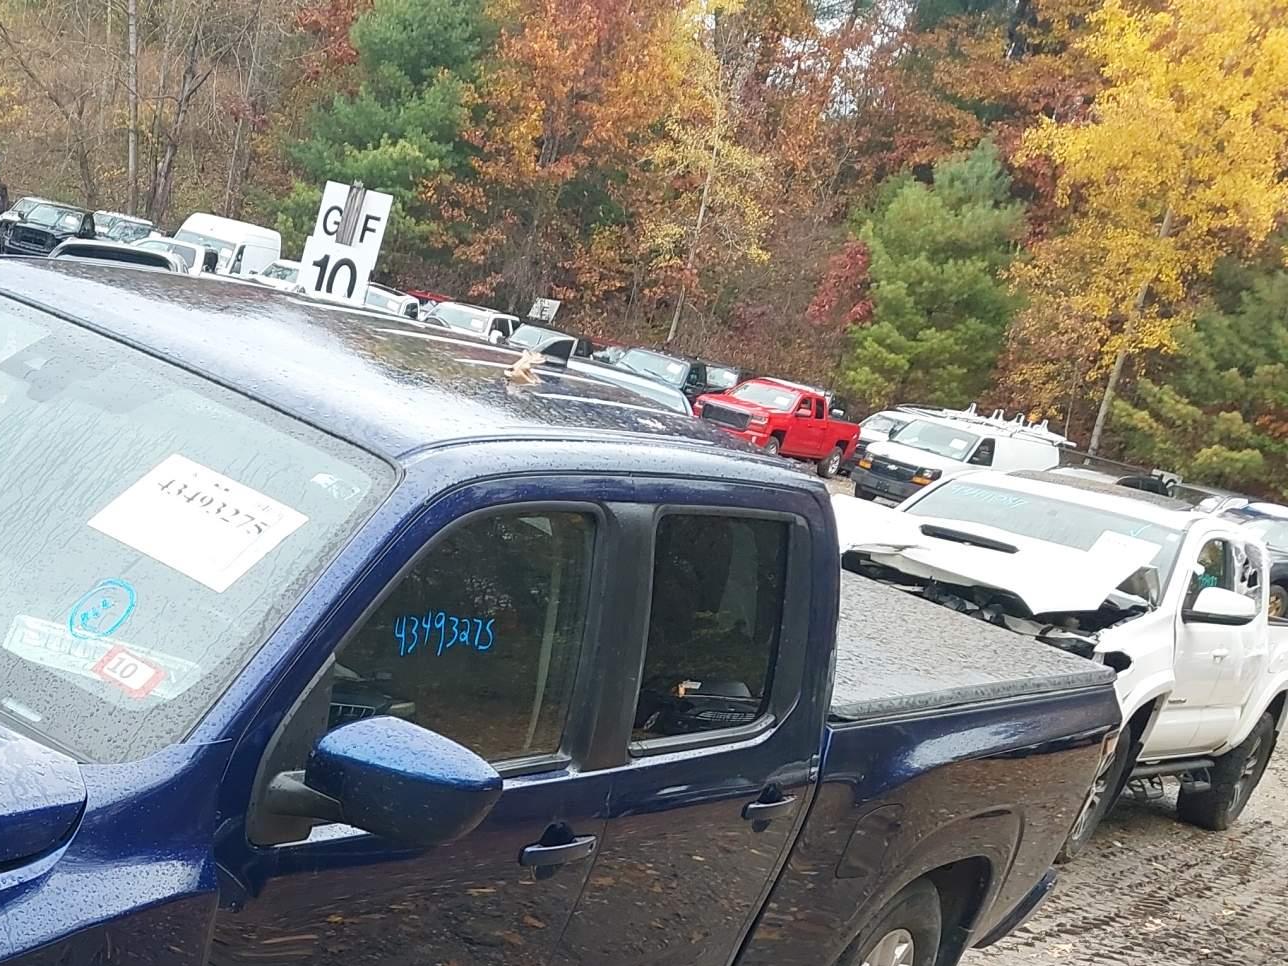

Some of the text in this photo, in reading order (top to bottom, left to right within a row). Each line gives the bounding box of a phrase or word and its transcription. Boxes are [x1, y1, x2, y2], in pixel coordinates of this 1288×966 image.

[323, 205, 382, 243] G F
[312, 254, 358, 299] 10
[157, 479, 270, 536] 43493275
[394, 609, 495, 657] 43493275
[107, 656, 138, 680] 10
